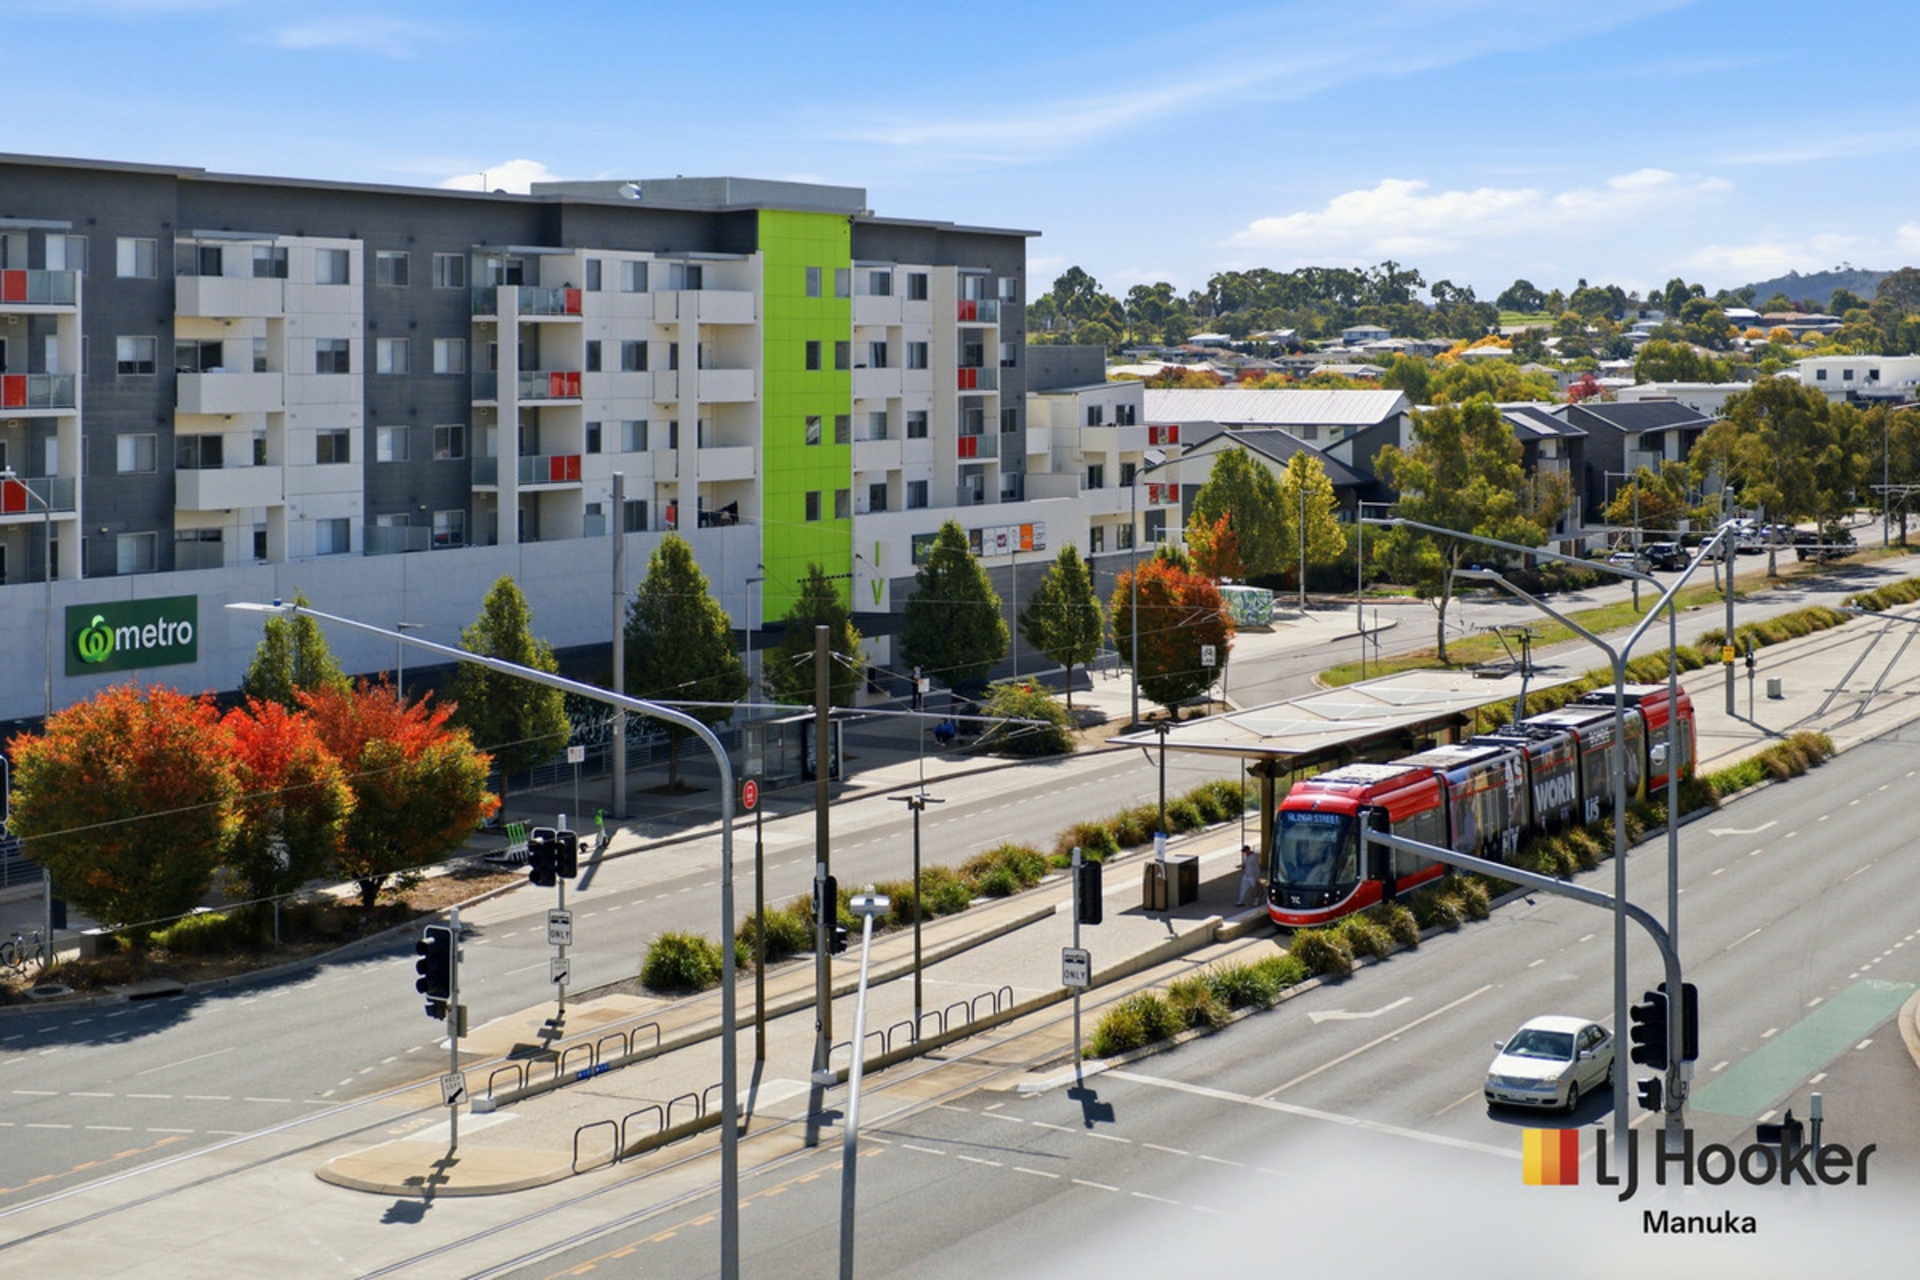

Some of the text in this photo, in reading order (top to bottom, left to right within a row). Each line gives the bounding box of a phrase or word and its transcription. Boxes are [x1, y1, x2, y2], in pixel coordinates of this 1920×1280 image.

[115, 616, 193, 651] metro
[1535, 771, 1576, 813] WORN
[550, 929, 570, 940] ONLY
[1064, 969, 1086, 980] ONLY
